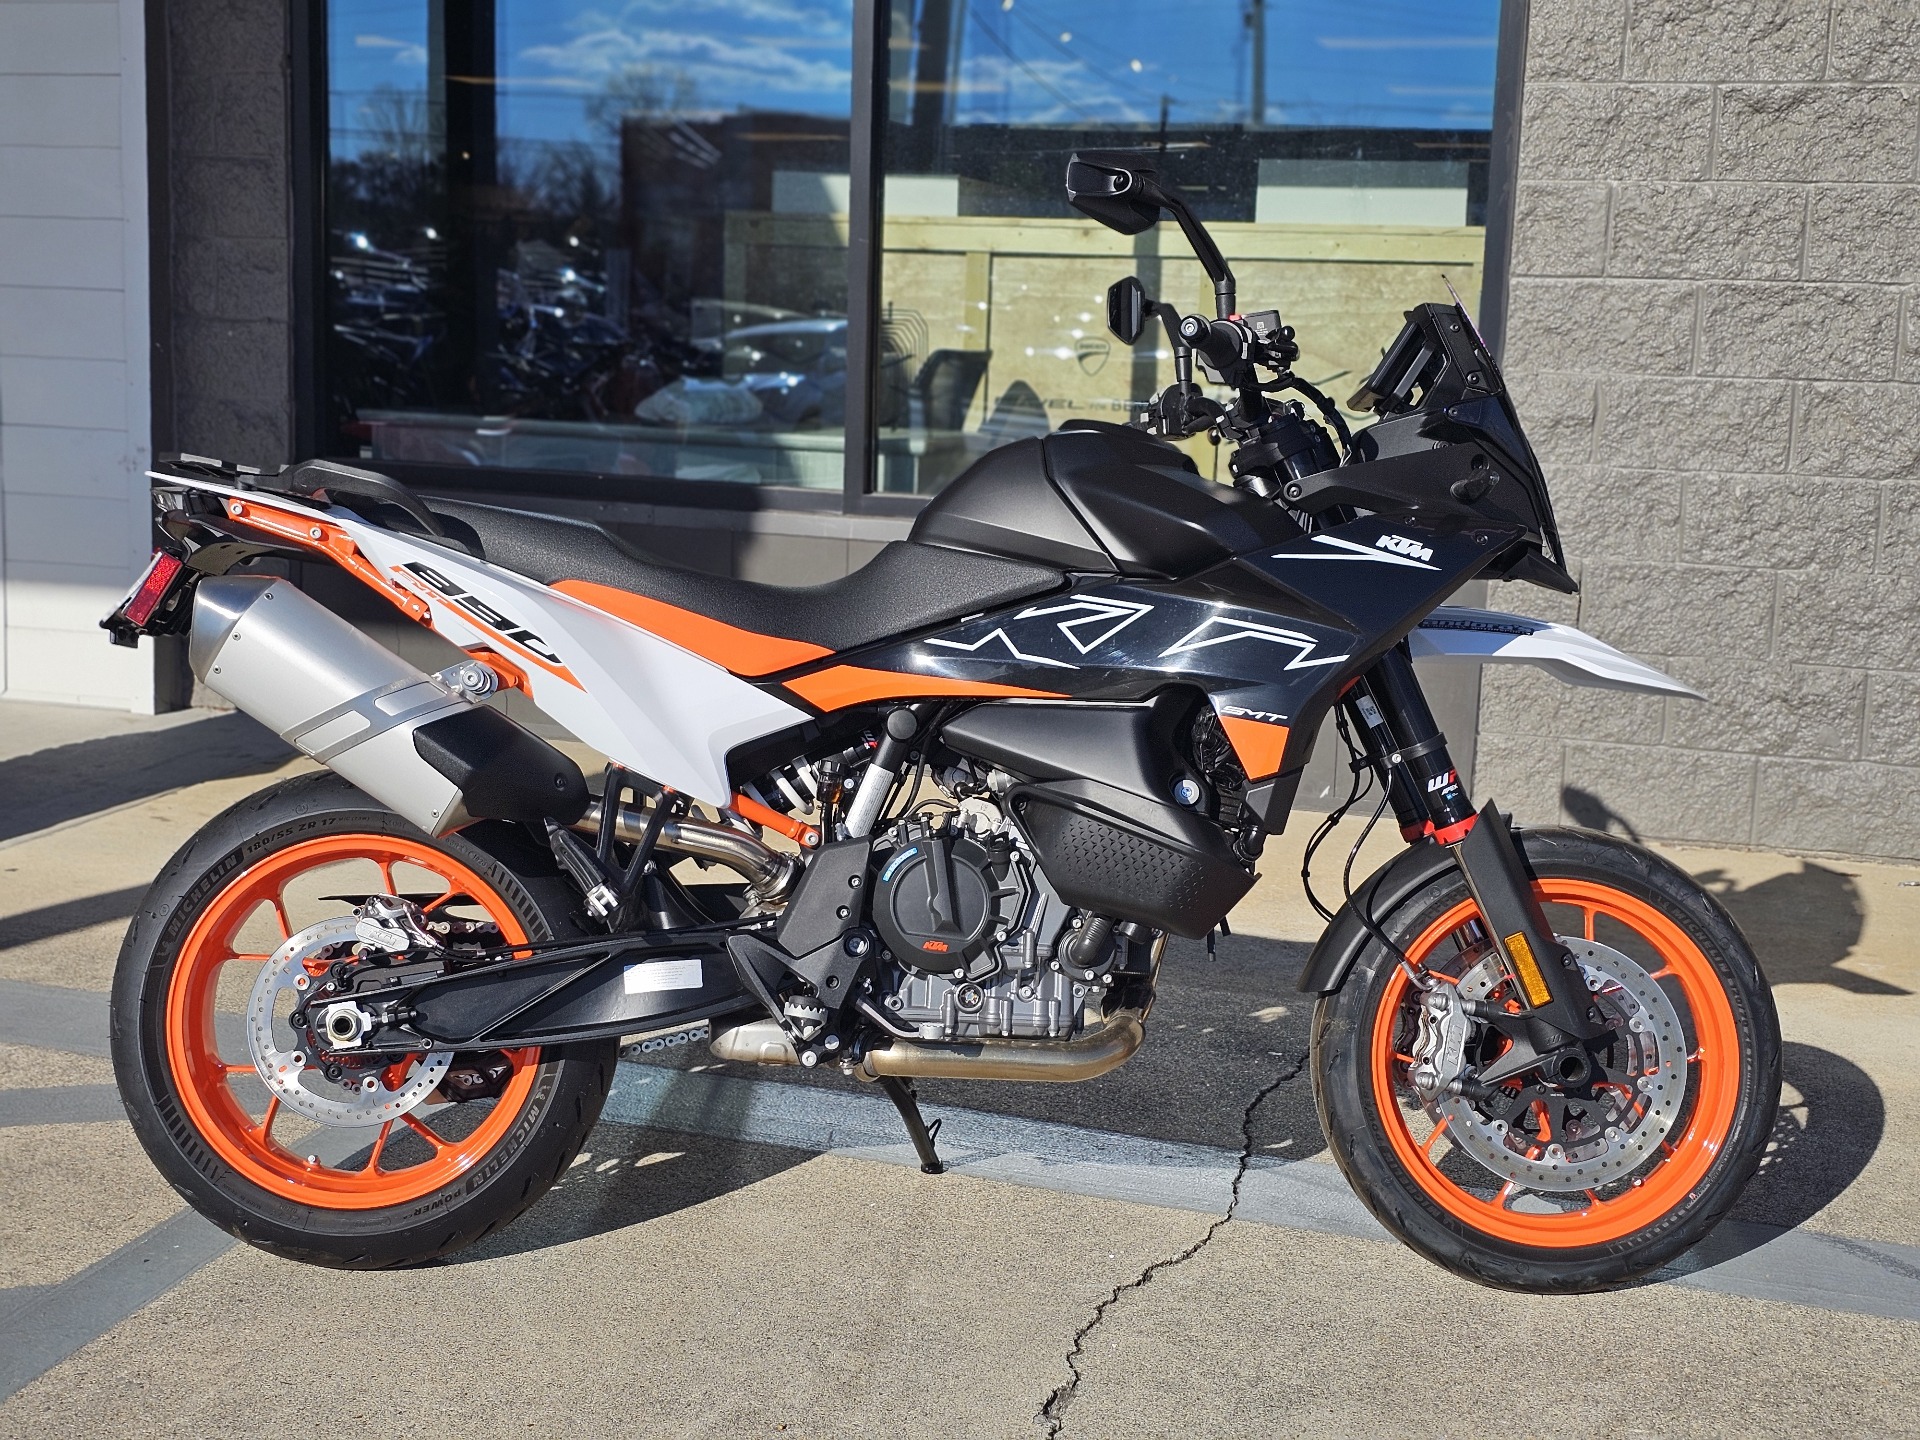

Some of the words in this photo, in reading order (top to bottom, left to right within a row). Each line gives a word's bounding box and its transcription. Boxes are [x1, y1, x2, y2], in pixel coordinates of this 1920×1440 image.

[1375, 534, 1434, 562] KTM
[1220, 705, 1288, 722] SMT
[1427, 769, 1457, 792] WP
[168, 853, 239, 937] MICHELIN
[246, 827, 294, 854] 180/55
[298, 820, 317, 832] ZR
[322, 817, 336, 826] 17
[922, 940, 949, 953] KTM
[1672, 907, 1731, 973] MICHELIN
[472, 1105, 541, 1187] MICHELIN
[414, 1189, 462, 1216] POWER
